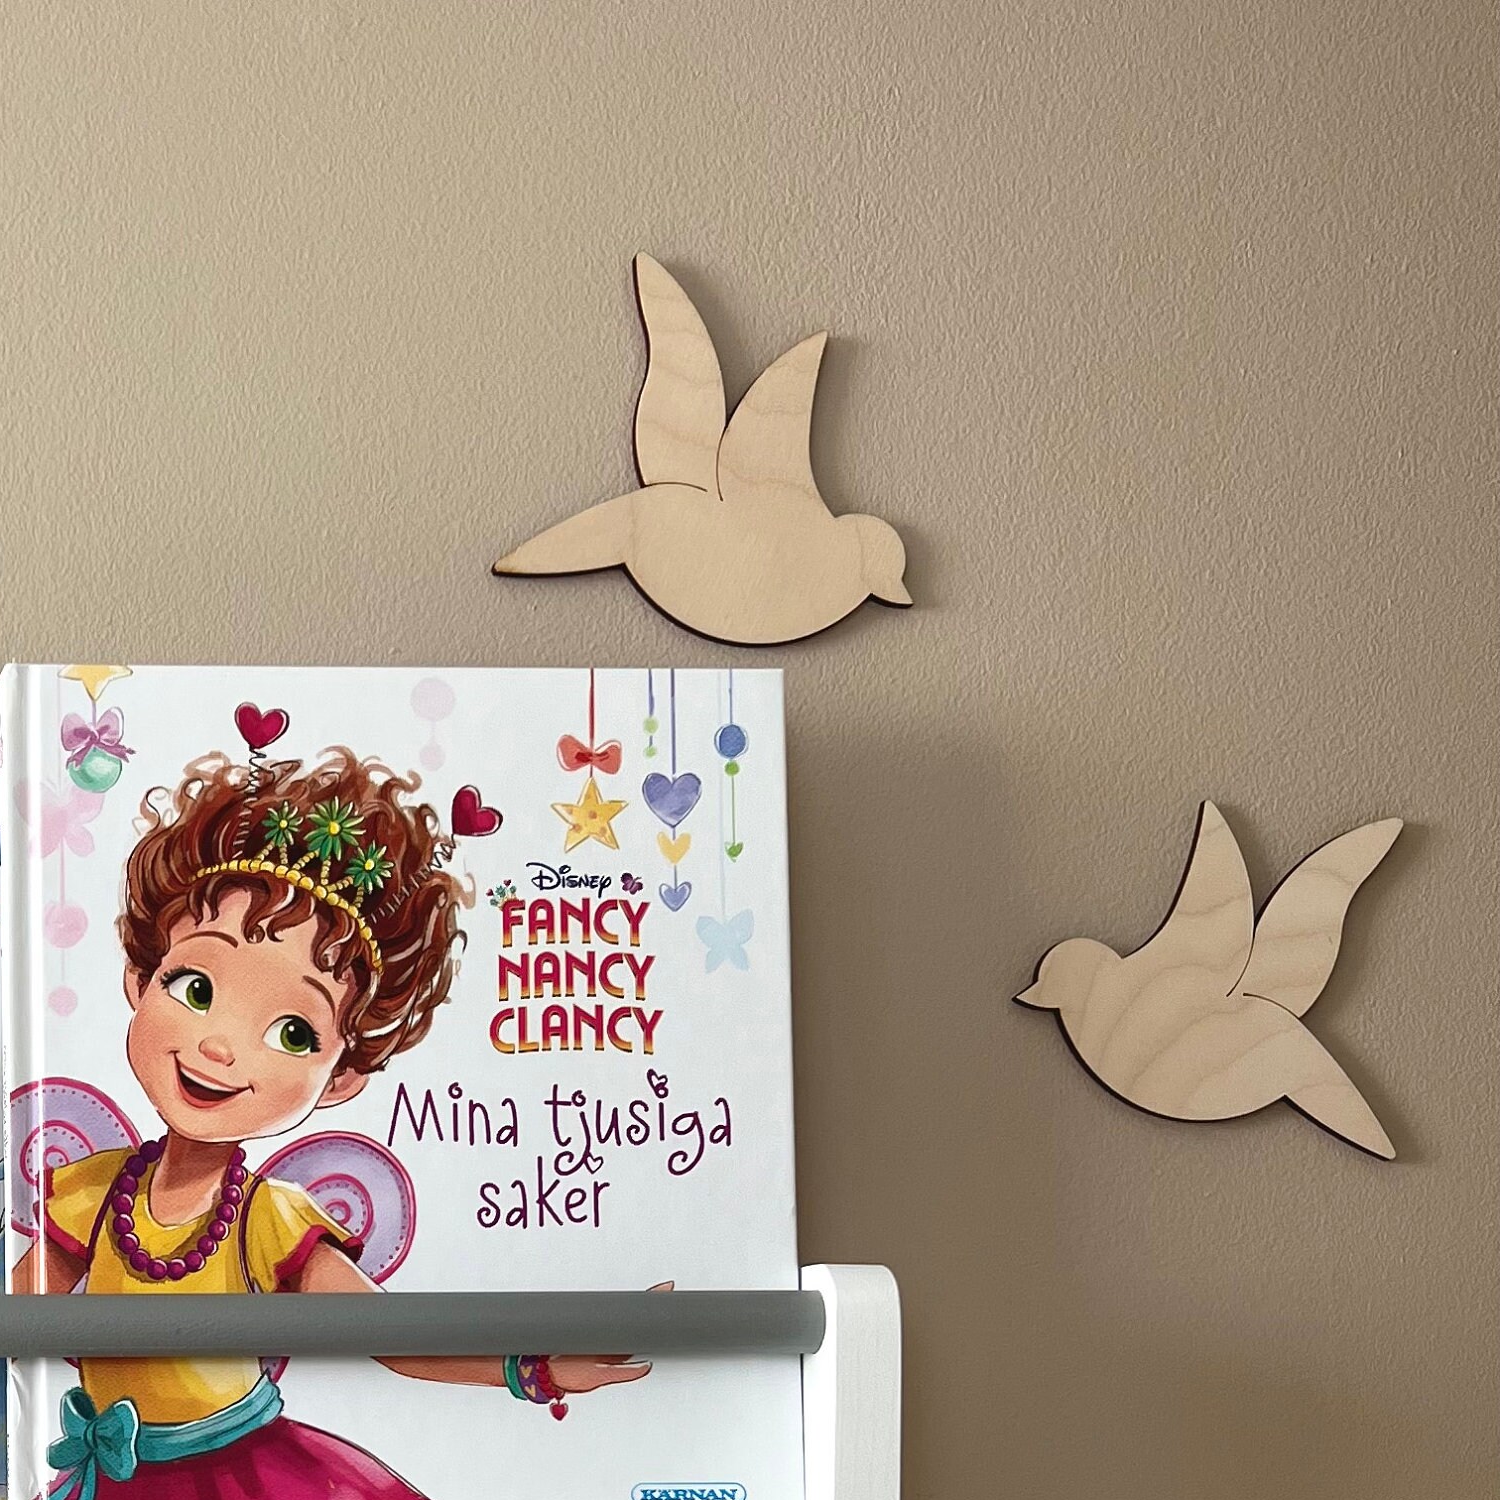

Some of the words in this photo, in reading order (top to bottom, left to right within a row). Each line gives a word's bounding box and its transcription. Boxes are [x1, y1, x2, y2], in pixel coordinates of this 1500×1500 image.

[501, 896, 651, 949] FANCY
[498, 950, 656, 1002] NANCY
[488, 1003, 664, 1056] CLANCY
[387, 1081, 519, 1148] Mina
[543, 1068, 733, 1176] tjusiga
[476, 1155, 611, 1229] saker
[639, 1488, 738, 1500] KÄRNAN
